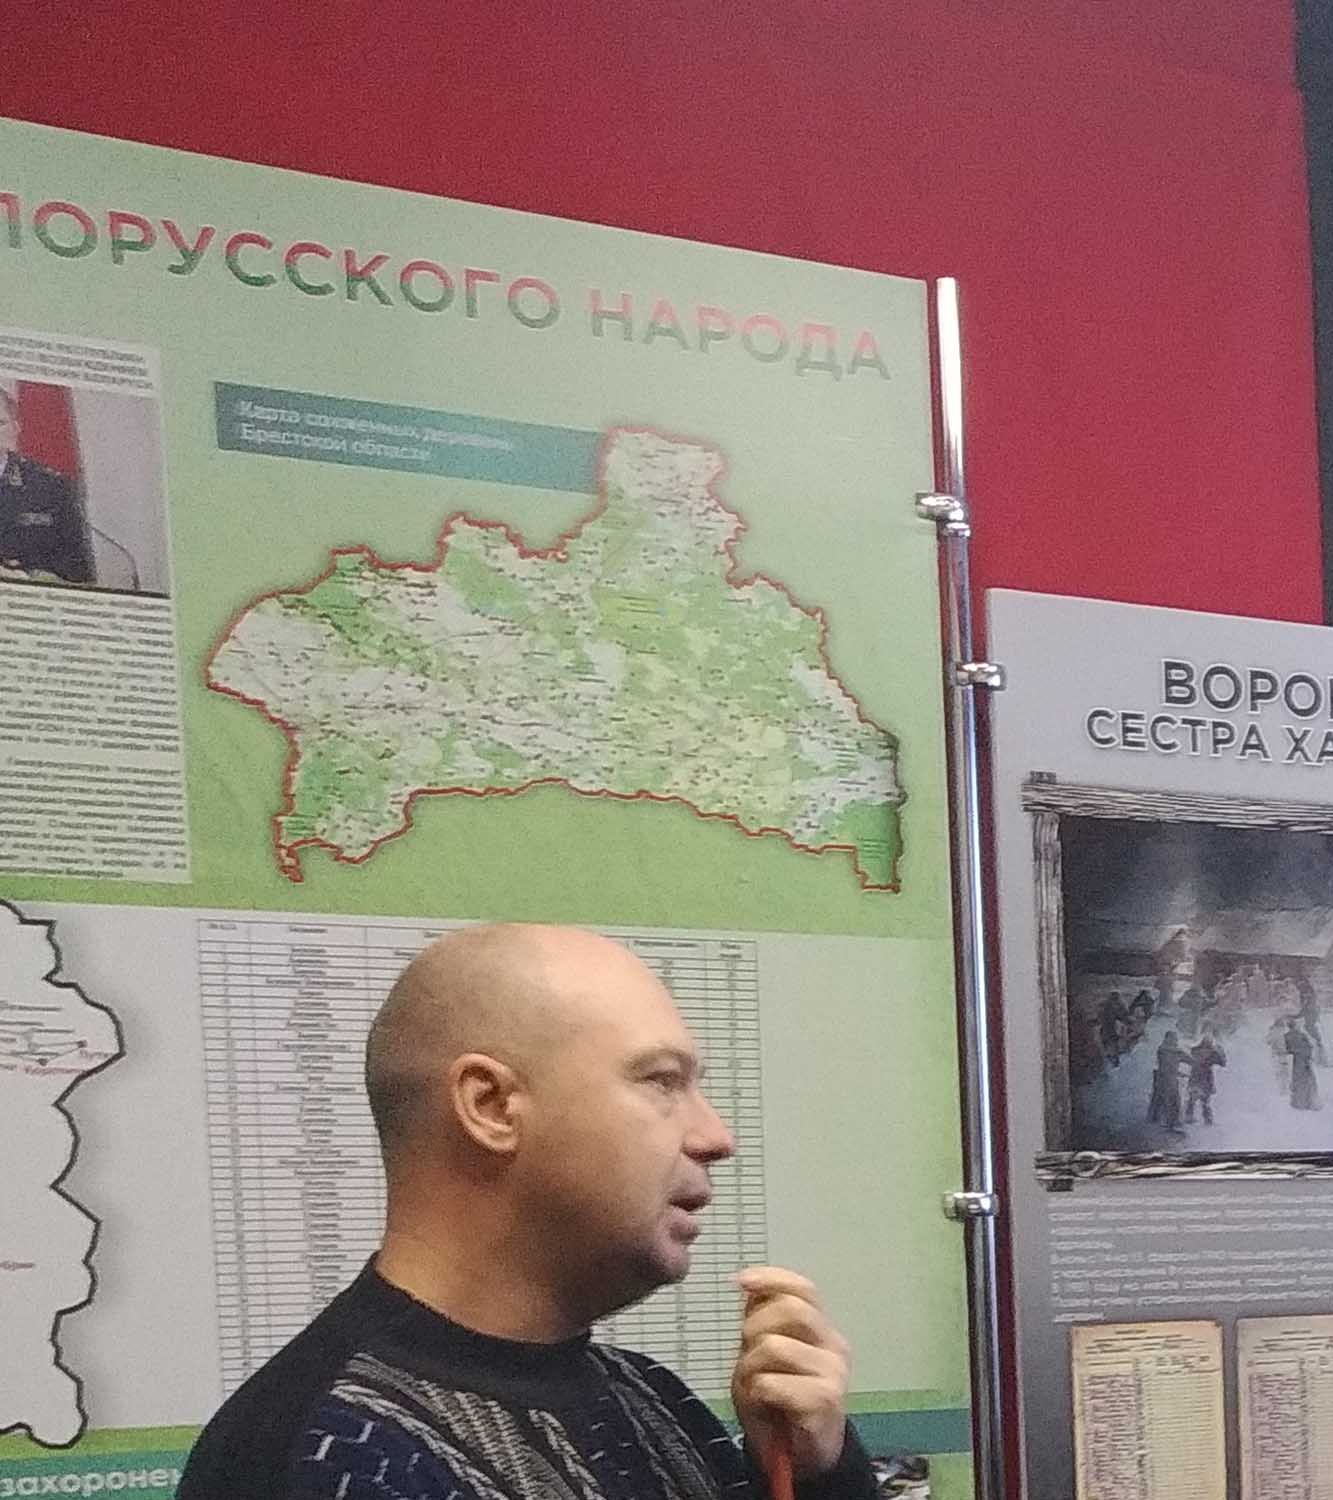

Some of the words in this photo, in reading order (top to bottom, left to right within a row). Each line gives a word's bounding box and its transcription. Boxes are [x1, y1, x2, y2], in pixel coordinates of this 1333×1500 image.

[589, 288, 892, 382] НАРОДА
[239, 400, 301, 424] Карта
[1088, 709, 1271, 761] СЕСТРА
